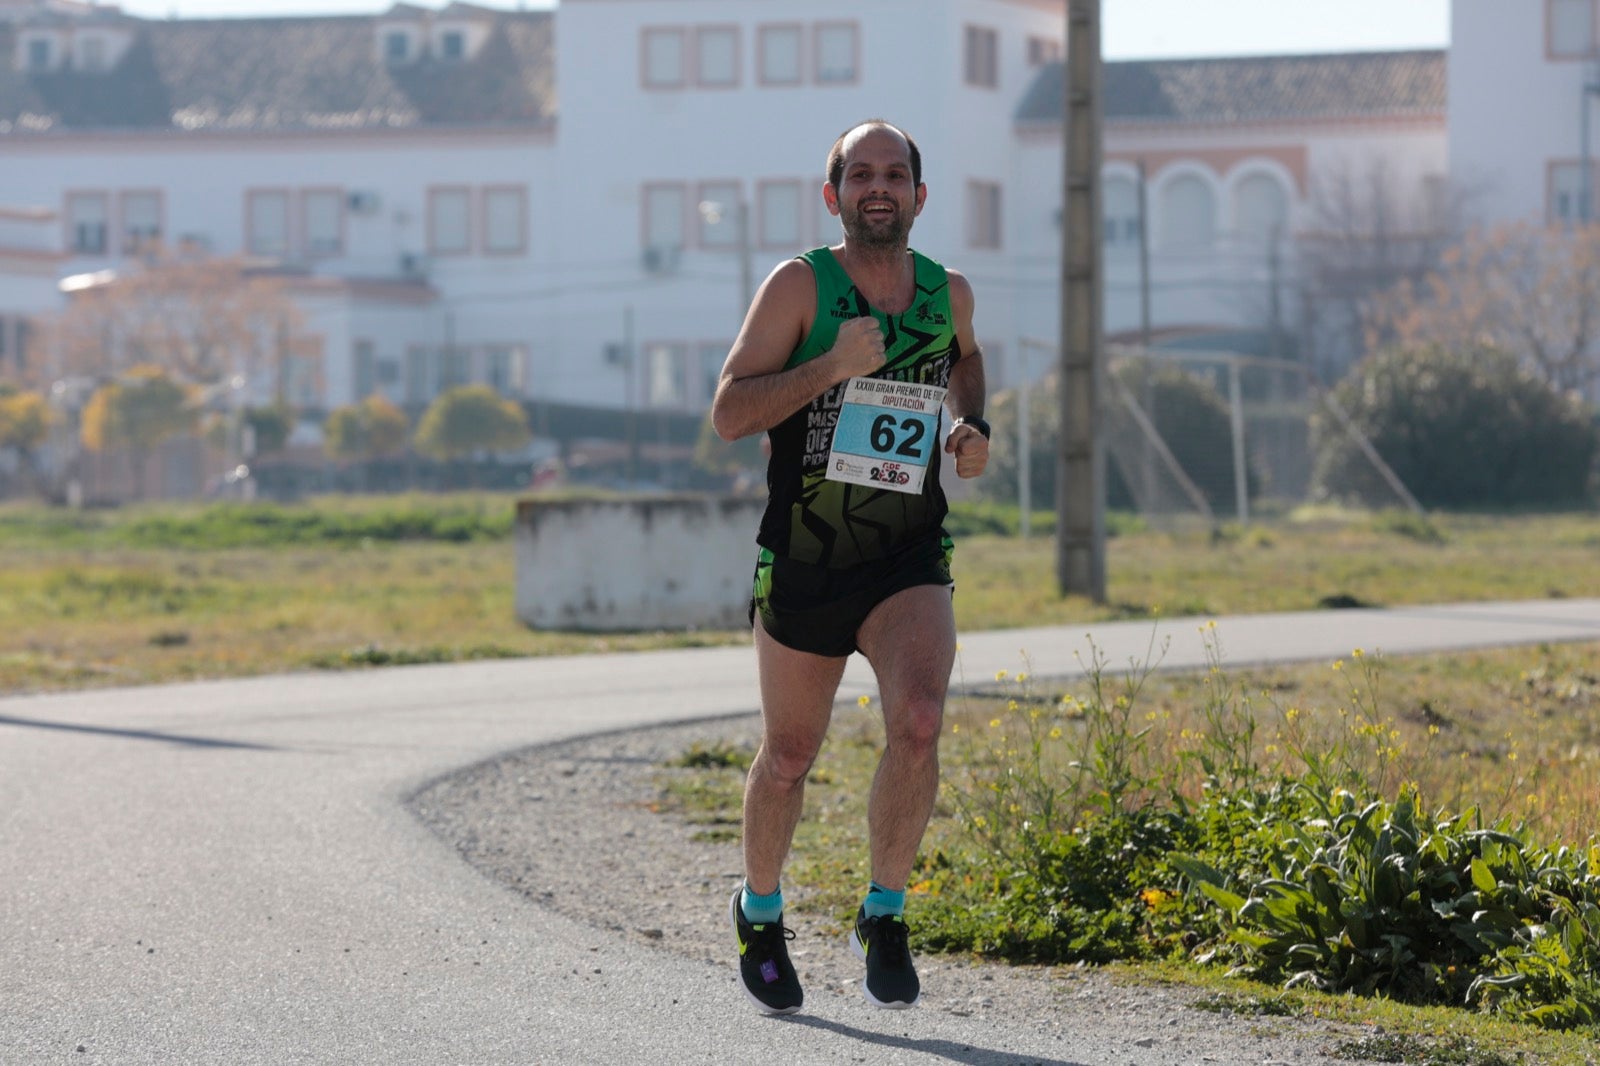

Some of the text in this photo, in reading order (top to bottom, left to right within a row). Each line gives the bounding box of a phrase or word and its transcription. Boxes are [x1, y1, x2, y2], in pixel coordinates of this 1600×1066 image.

[854, 380, 876, 392] XXXIII
[876, 383, 895, 395] GRAN
[896, 386, 922, 398] PREMIO
[923, 389, 934, 400] DE
[882, 395, 926, 411] DIPUTACIÓN
[870, 414, 925, 459] 62
